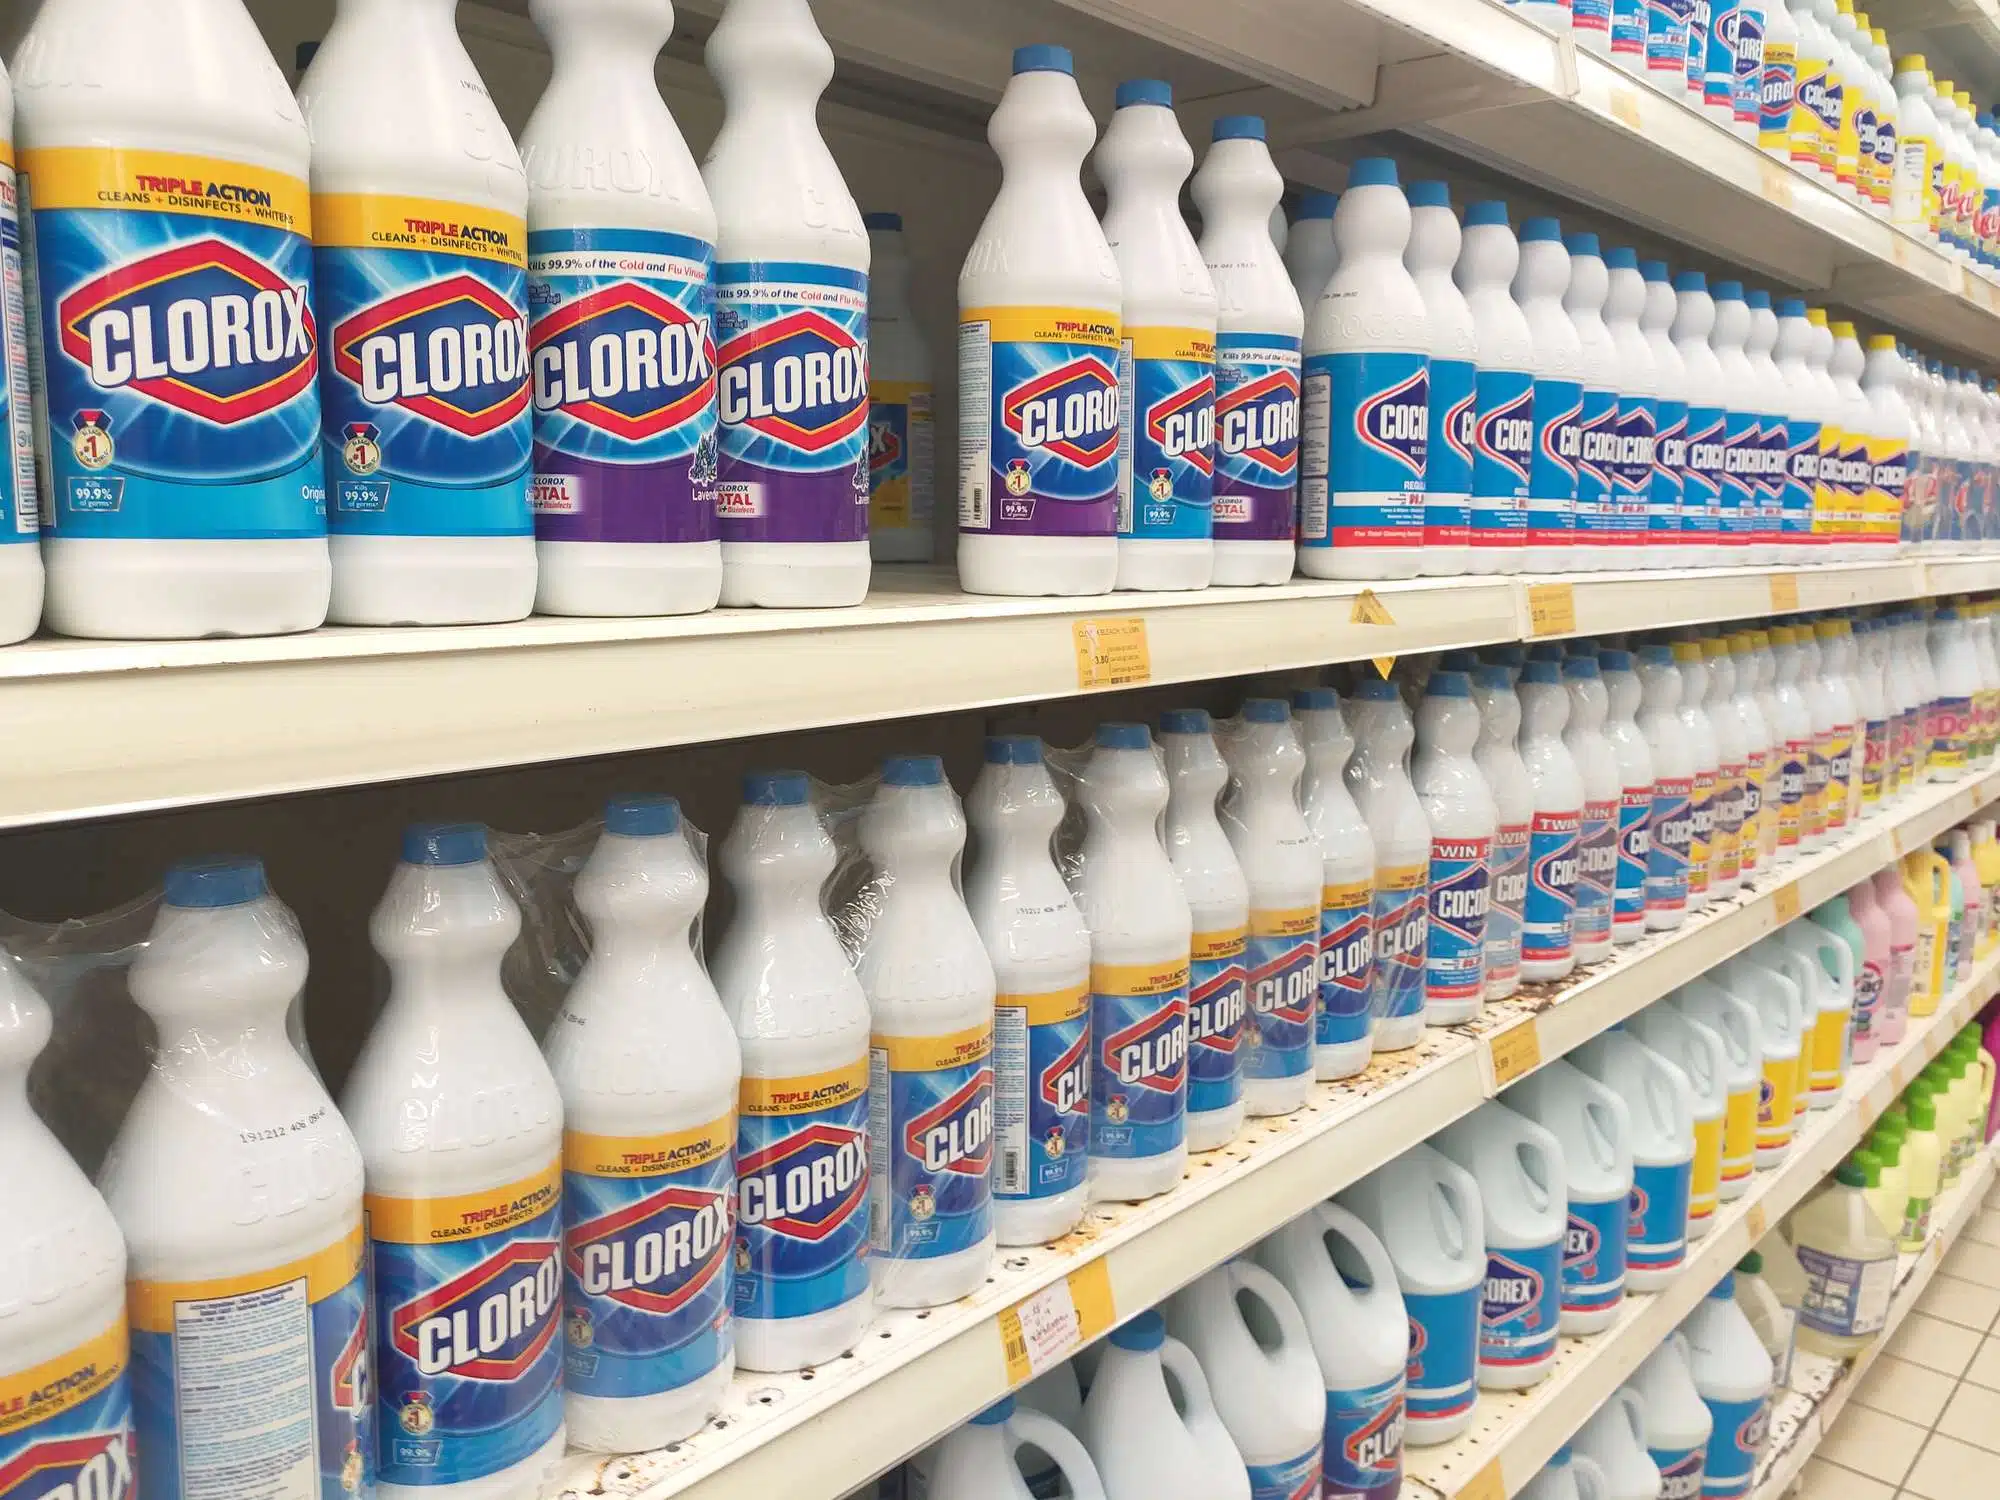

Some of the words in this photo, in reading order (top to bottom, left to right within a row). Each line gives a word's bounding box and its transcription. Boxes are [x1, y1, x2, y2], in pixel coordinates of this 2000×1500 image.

[98, 191, 150, 203] CLEANS
[168, 195, 241, 213] DISINFECTS
[136, 175, 203, 196] TRIPLE
[206, 182, 271, 208] ACTION
[371, 231, 416, 244] CLEANS
[430, 235, 488, 253] DISINFECTS
[404, 218, 458, 237] TRIPLE
[461, 224, 508, 247] ACTION
[548, 259, 583, 271] 99.9%
[585, 259, 597, 270] of
[599, 259, 616, 270] the
[619, 259, 644, 270] Cold
[646, 262, 665, 272] and
[668, 263, 682, 275] Flu
[736, 288, 769, 299] 99.9%
[771, 289, 782, 298] of
[783, 290, 798, 299] the
[801, 290, 821, 301] Cold
[823, 293, 838, 302] and
[90, 285, 309, 387] CLOROX
[1056, 322, 1087, 333] TRIPLE
[1089, 324, 1114, 335] ACTION
[362, 315, 529, 402] CLOROX
[534, 318, 709, 410] CLOROX
[719, 342, 868, 425] CLOROX
[75, 488, 113, 500] 99.9%
[345, 491, 379, 502] 99.9%
[534, 486, 570, 501] OTAL
[717, 492, 753, 506] OTAL
[1214, 504, 1245, 514] OTAL
[770, 1091, 810, 1104] TRIPLE
[811, 1080, 850, 1099] ACTION
[621, 1151, 666, 1165] TRIPLE
[667, 1138, 711, 1160] ACTION
[595, 1164, 631, 1173] CLEANS
[738, 1130, 868, 1225] CLOROX
[459, 1203, 508, 1226] TRIPLE
[509, 1184, 552, 1213] ACTION
[430, 1225, 472, 1239] CLEANS
[583, 1183, 732, 1295] CLOROX
[28, 1362, 97, 1406] ACTION
